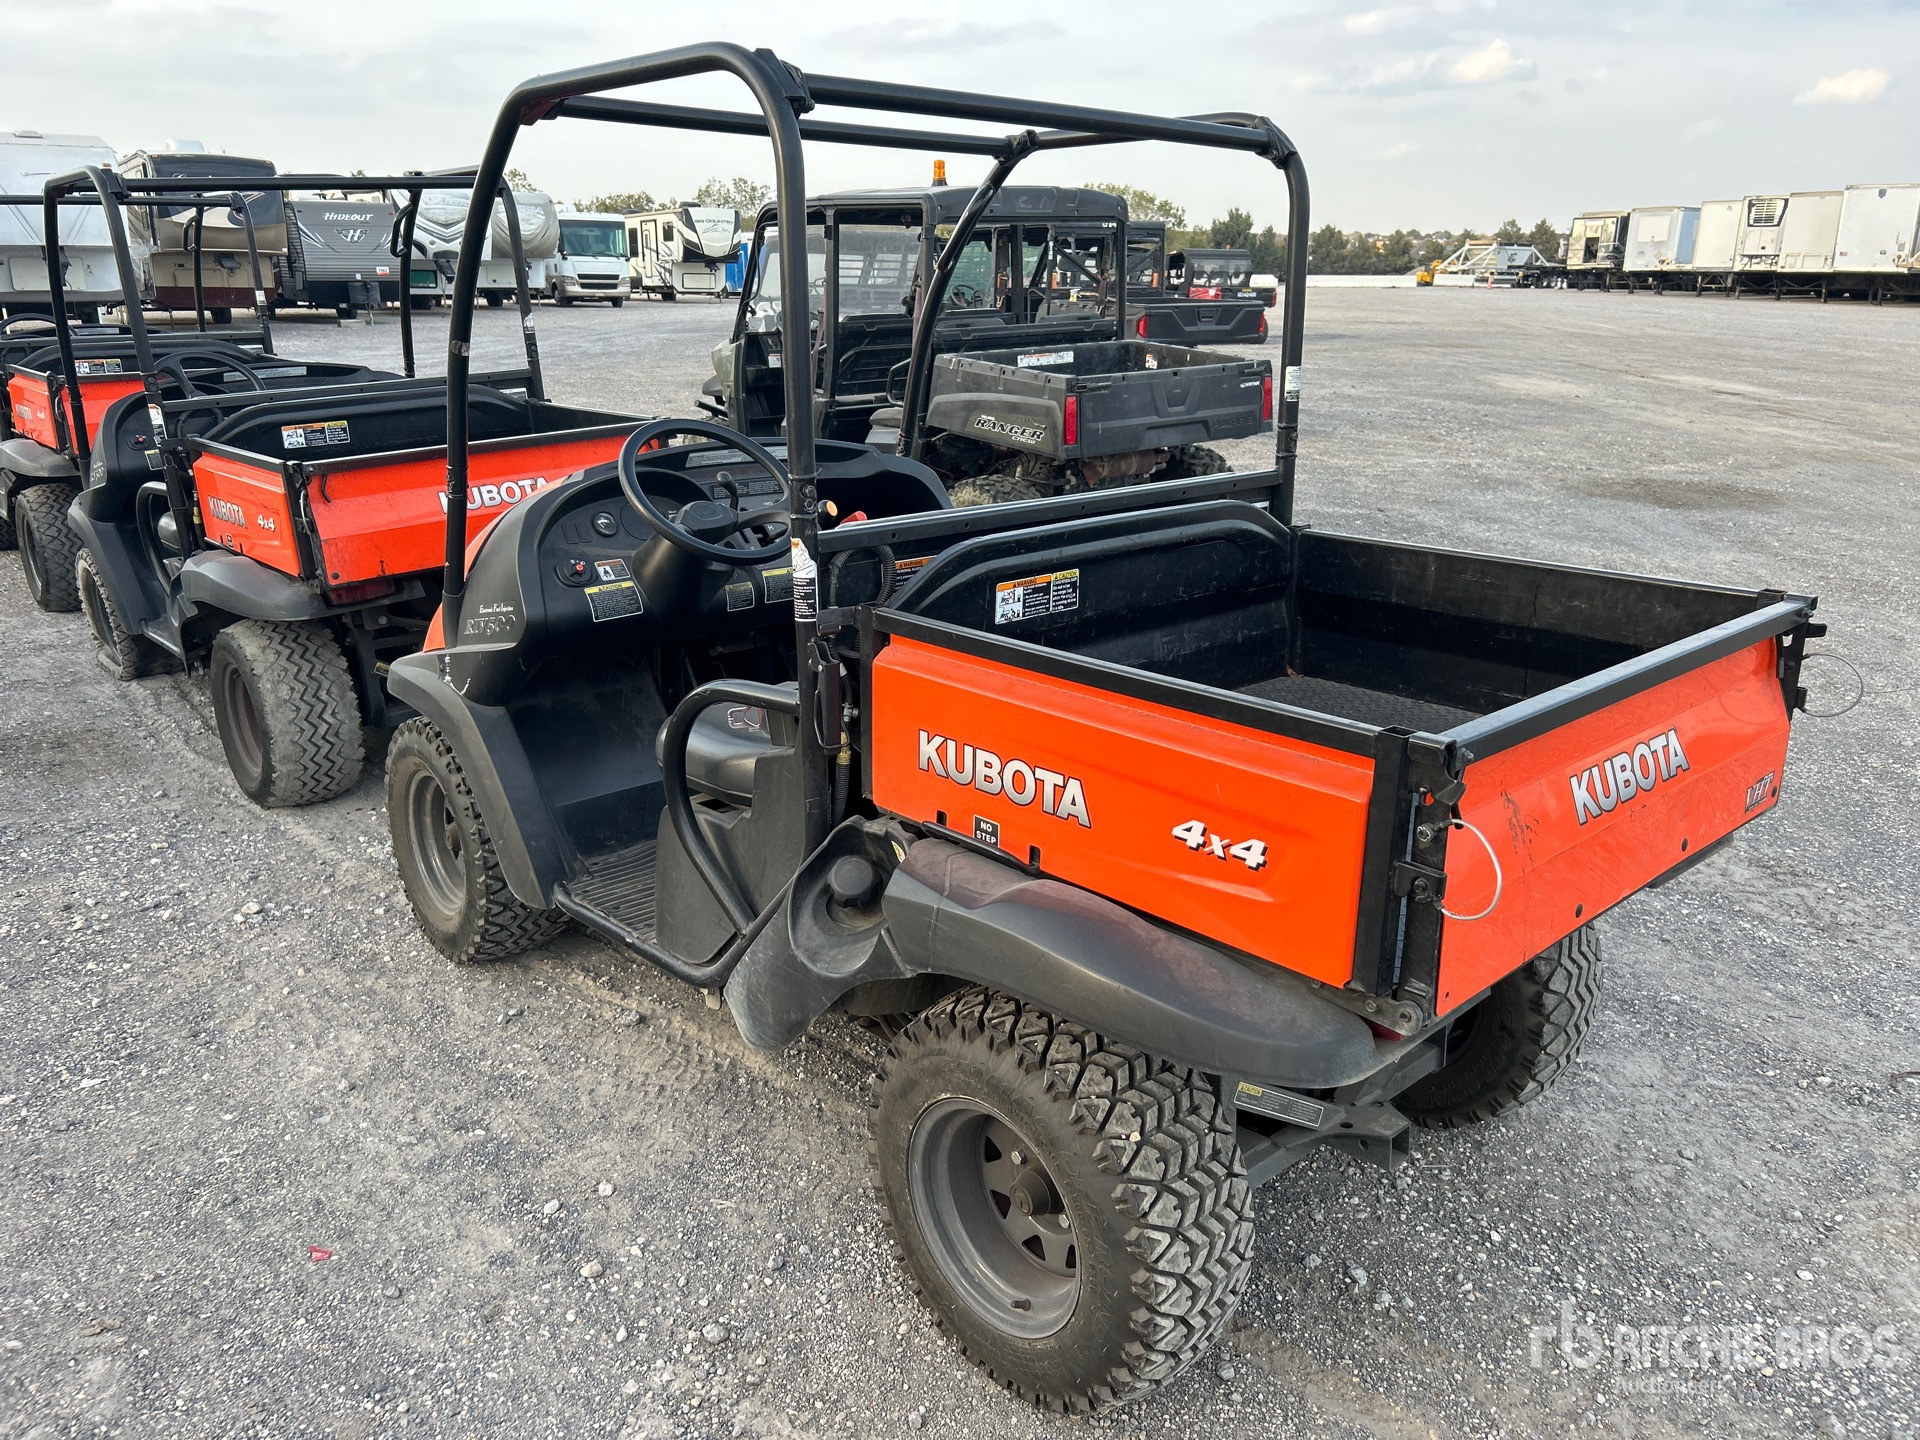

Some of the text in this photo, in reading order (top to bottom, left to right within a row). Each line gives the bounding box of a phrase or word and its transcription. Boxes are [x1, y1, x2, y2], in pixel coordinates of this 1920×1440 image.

[324, 212, 374, 221] HIDEOUT
[974, 418, 1044, 441] RANGER
[208, 495, 275, 532] KUBOTA 4x4
[903, 560, 923, 568] WARNING
[1059, 571, 1078, 579] CAUTION
[1017, 578, 1037, 588] WARNING
[918, 729, 1092, 829] KUBOTA
[1569, 725, 1690, 826] KUBOTA
[980, 821, 993, 832] NO
[976, 830, 997, 844] STEP
[1171, 820, 1268, 872] 4x4
